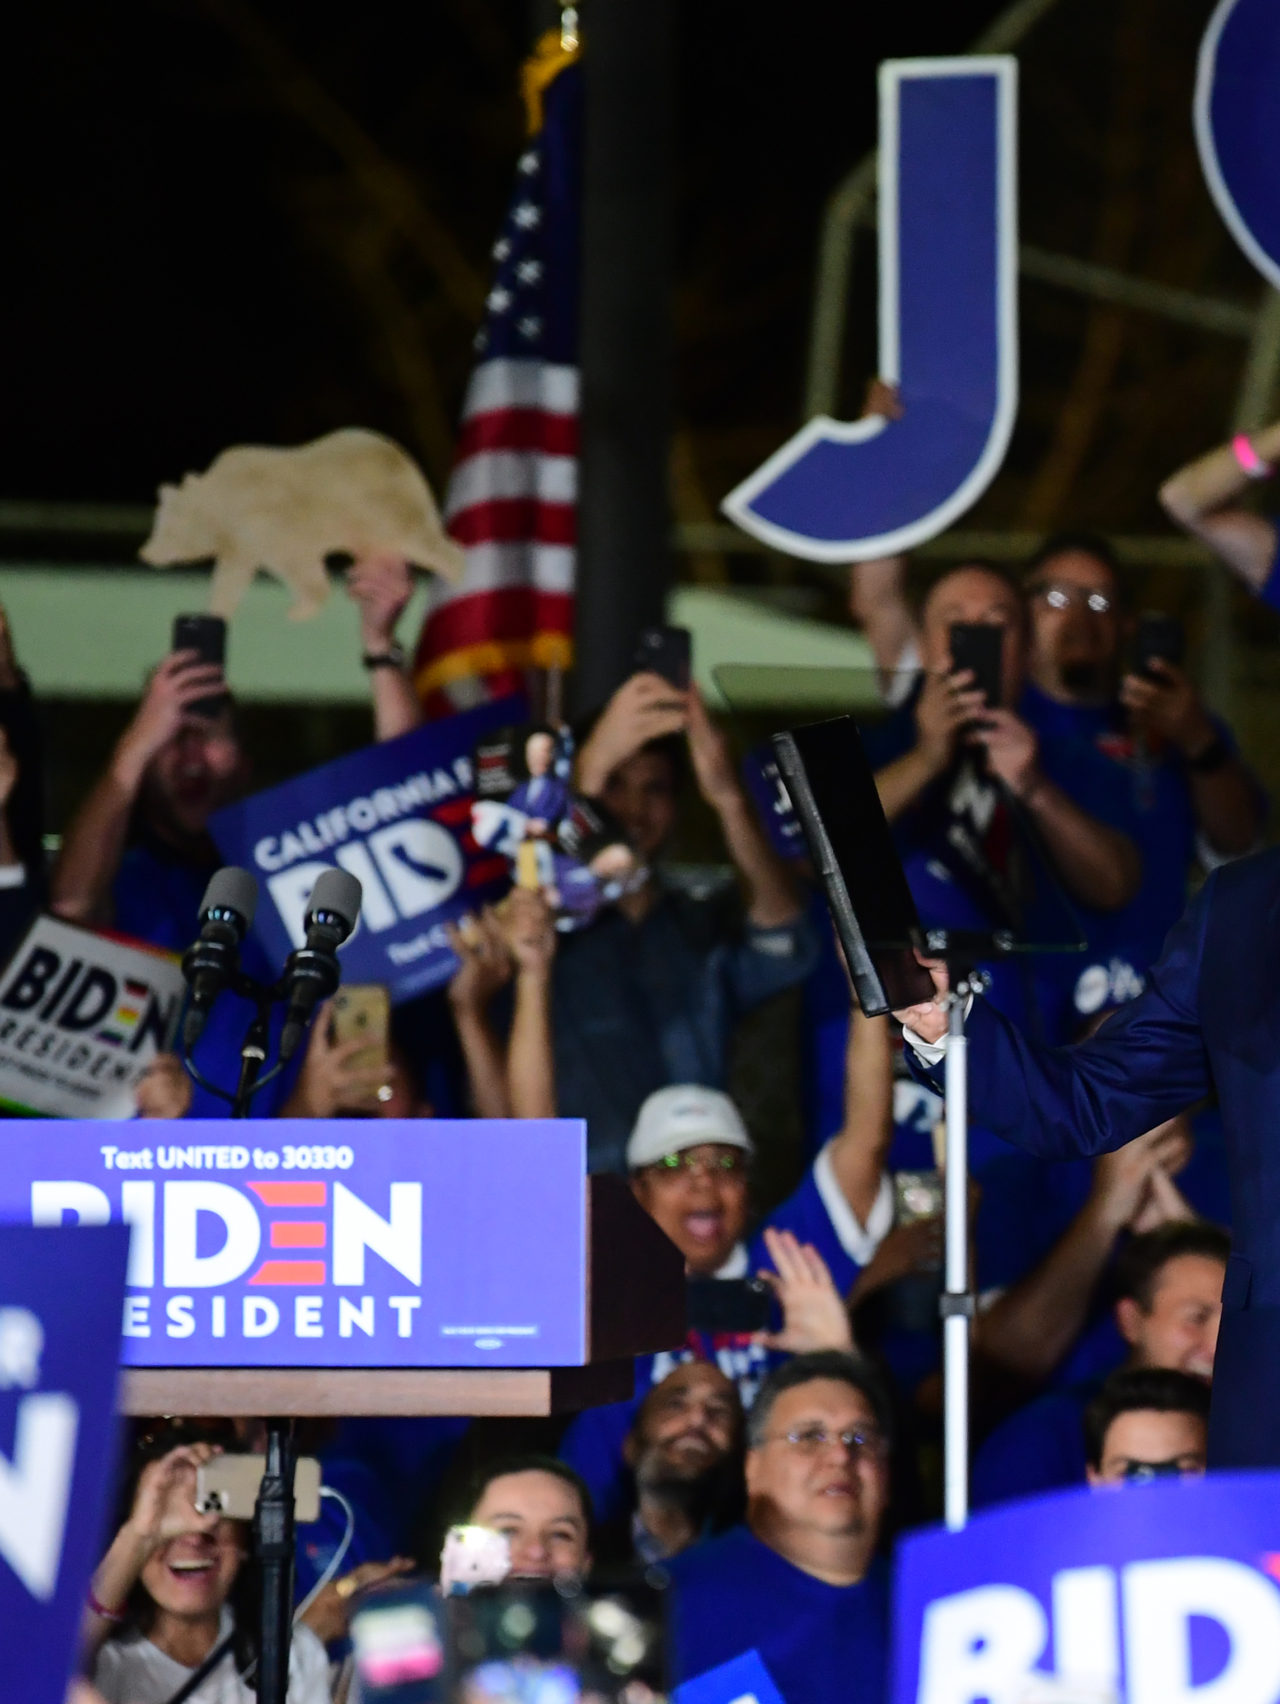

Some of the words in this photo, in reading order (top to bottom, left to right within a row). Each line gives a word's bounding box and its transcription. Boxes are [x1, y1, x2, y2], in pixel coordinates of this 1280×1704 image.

[254, 767, 457, 871] CALIFORNIA
[3, 945, 178, 1054] BIDEN
[101, 1145, 154, 1169] Text
[156, 1145, 250, 1169] UNITED
[252, 1147, 280, 1169] to
[281, 1145, 354, 1169] 30330
[122, 1295, 421, 1338] ESIDENT
